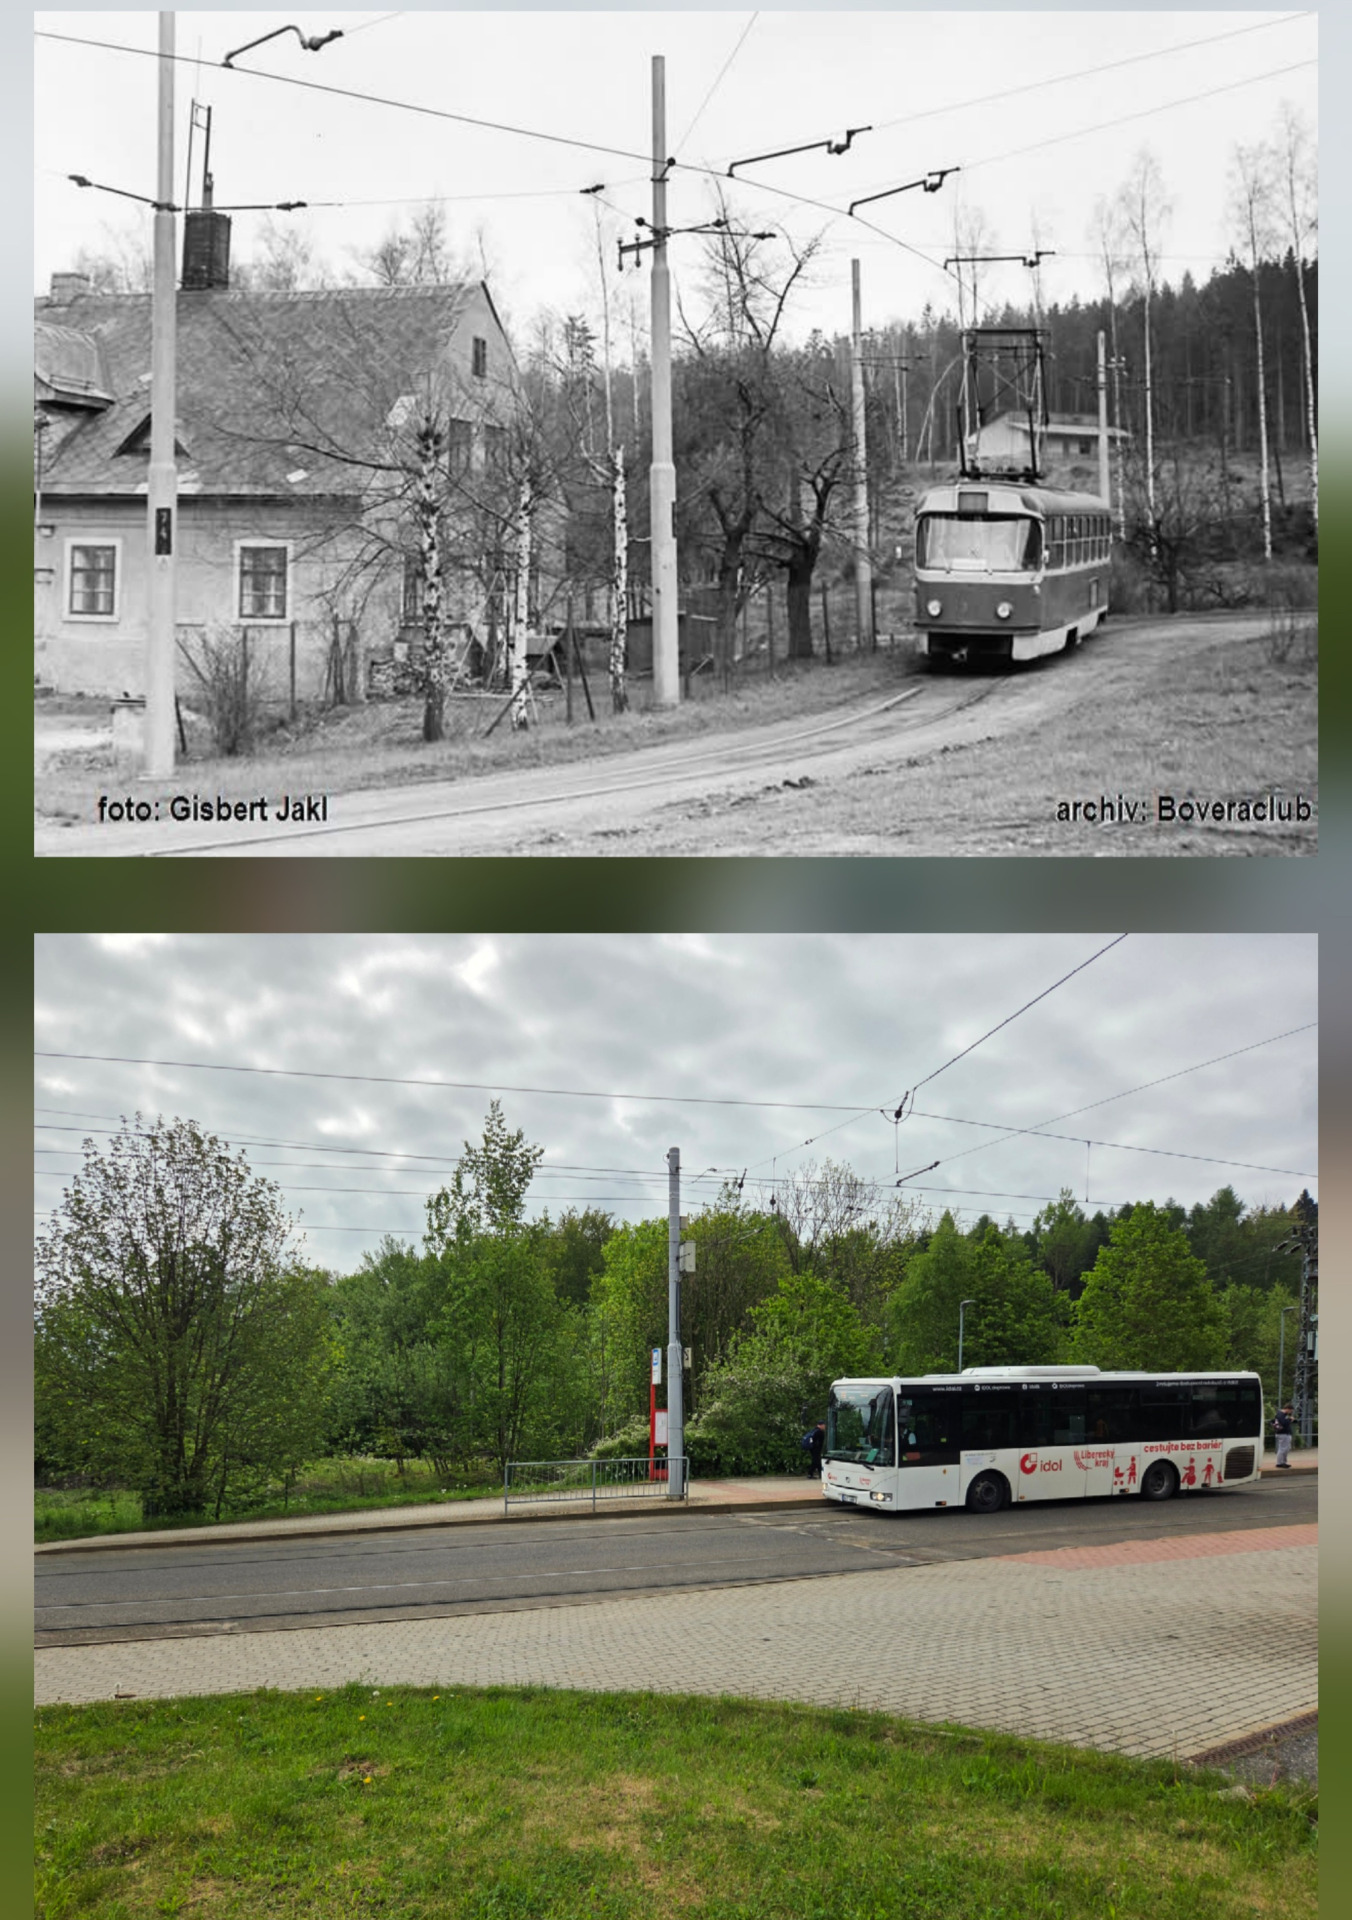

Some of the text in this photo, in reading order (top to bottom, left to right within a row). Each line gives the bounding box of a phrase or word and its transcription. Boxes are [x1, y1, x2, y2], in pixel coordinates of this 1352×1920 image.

[1081, 1449, 1115, 1459] Liberecký
[1144, 1439, 1223, 1455] cestujte bez bariér
[1040, 1458, 1062, 1472] idol
